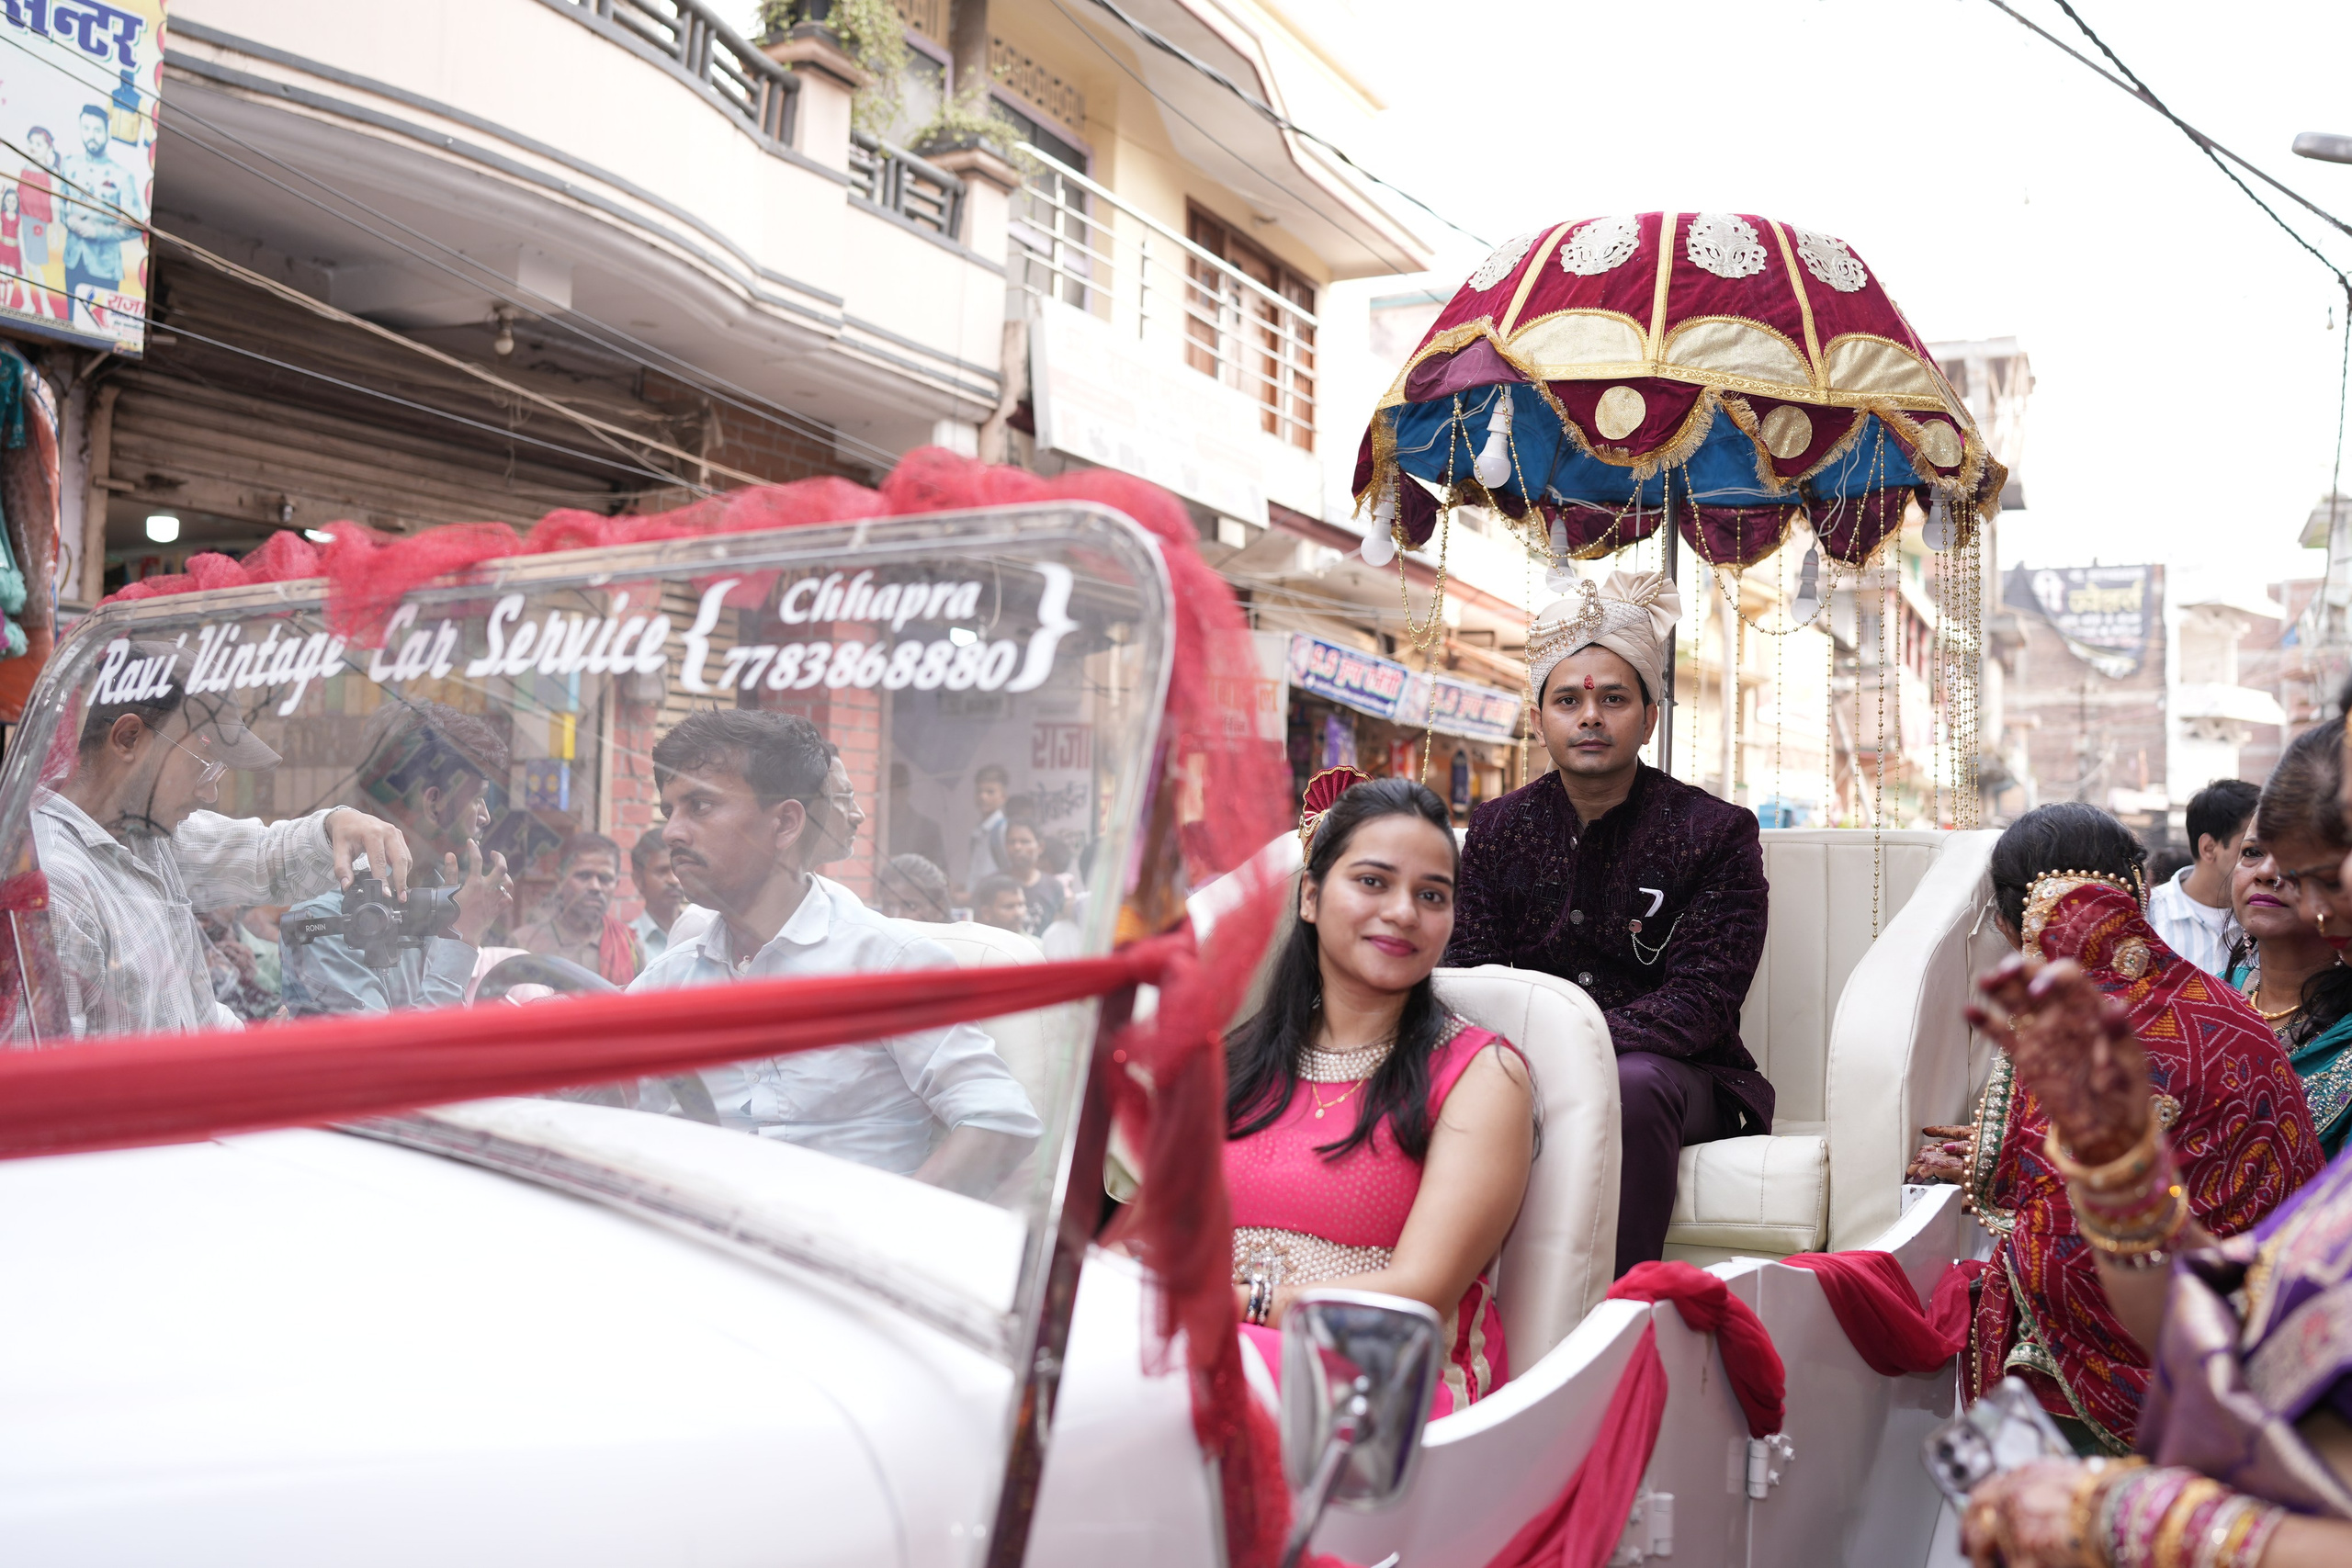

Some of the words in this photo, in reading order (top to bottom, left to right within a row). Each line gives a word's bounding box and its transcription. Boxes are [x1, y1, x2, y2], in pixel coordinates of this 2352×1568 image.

[778, 568, 984, 634] Chhapra
[86, 633, 188, 707] Ravi
[184, 622, 347, 716] Vintage
[368, 603, 458, 683] Car
[466, 591, 672, 678] Service
[716, 638, 1018, 693] 7783868880
[1031, 721, 1093, 771] राजा
[305, 923, 327, 932] RONIN
